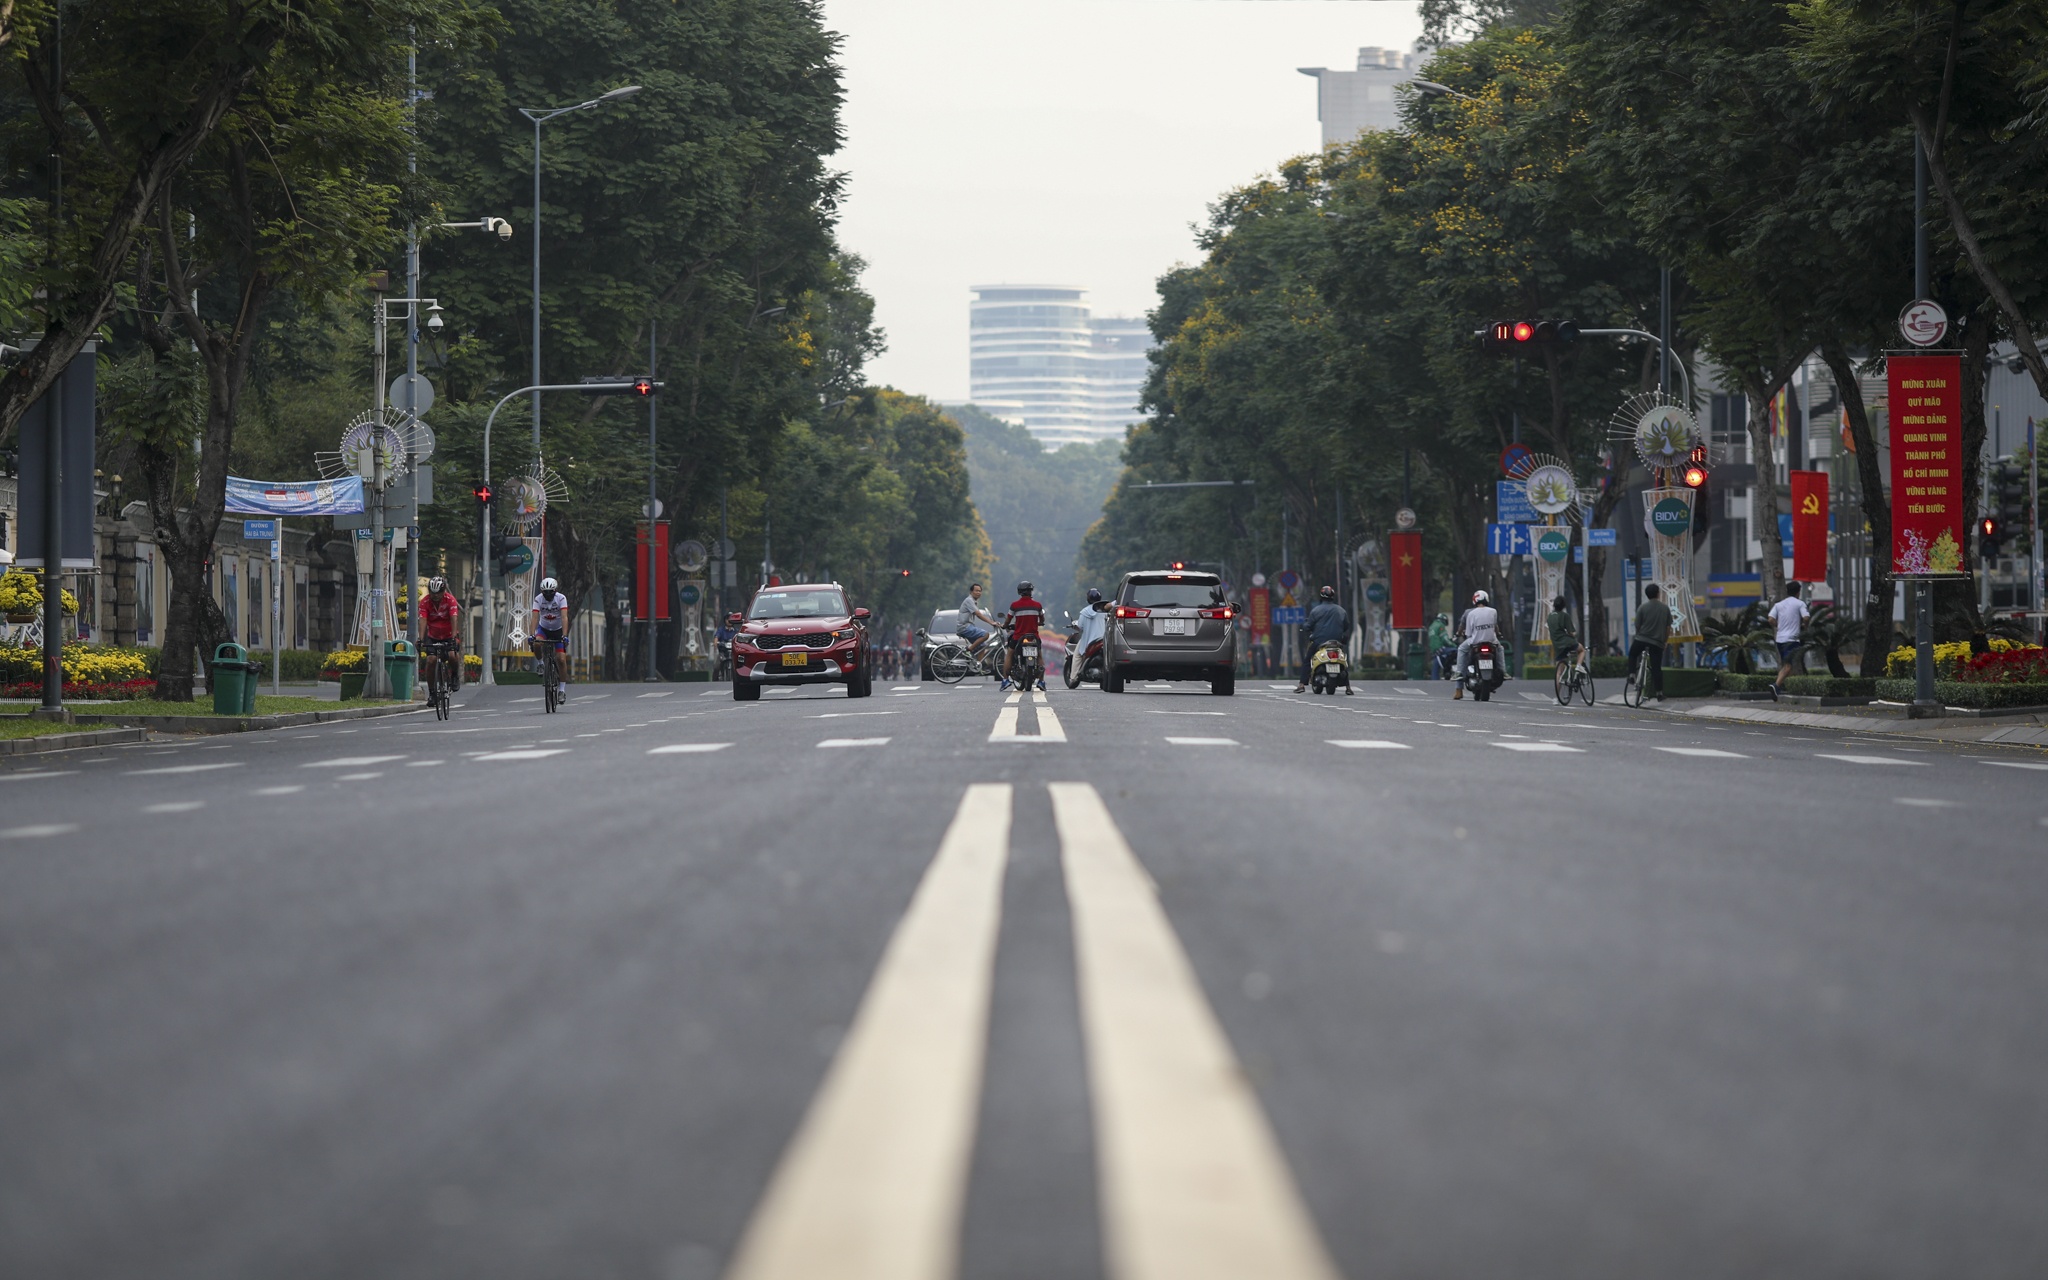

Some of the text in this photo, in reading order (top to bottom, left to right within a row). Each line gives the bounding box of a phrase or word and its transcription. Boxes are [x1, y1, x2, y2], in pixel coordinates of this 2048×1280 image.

[1902, 378, 1946, 389] MỪNG XUÂN
[1908, 396, 1941, 407] QUÝ MÃO
[1903, 412, 1947, 425] MỪNG ĐẢNG
[1903, 433, 1947, 443] QUANG VINH
[1905, 448, 1946, 460] THÀNH PHỐ
[1915, 467, 1928, 478] CHÍ
[1929, 469, 1949, 477] MINH
[1906, 485, 1947, 496] VỮNG VÀNG
[1908, 502, 1946, 514] TIẾN BƯỚC
[1655, 511, 1679, 521] BIDV
[1540, 542, 1559, 550] BIDV
